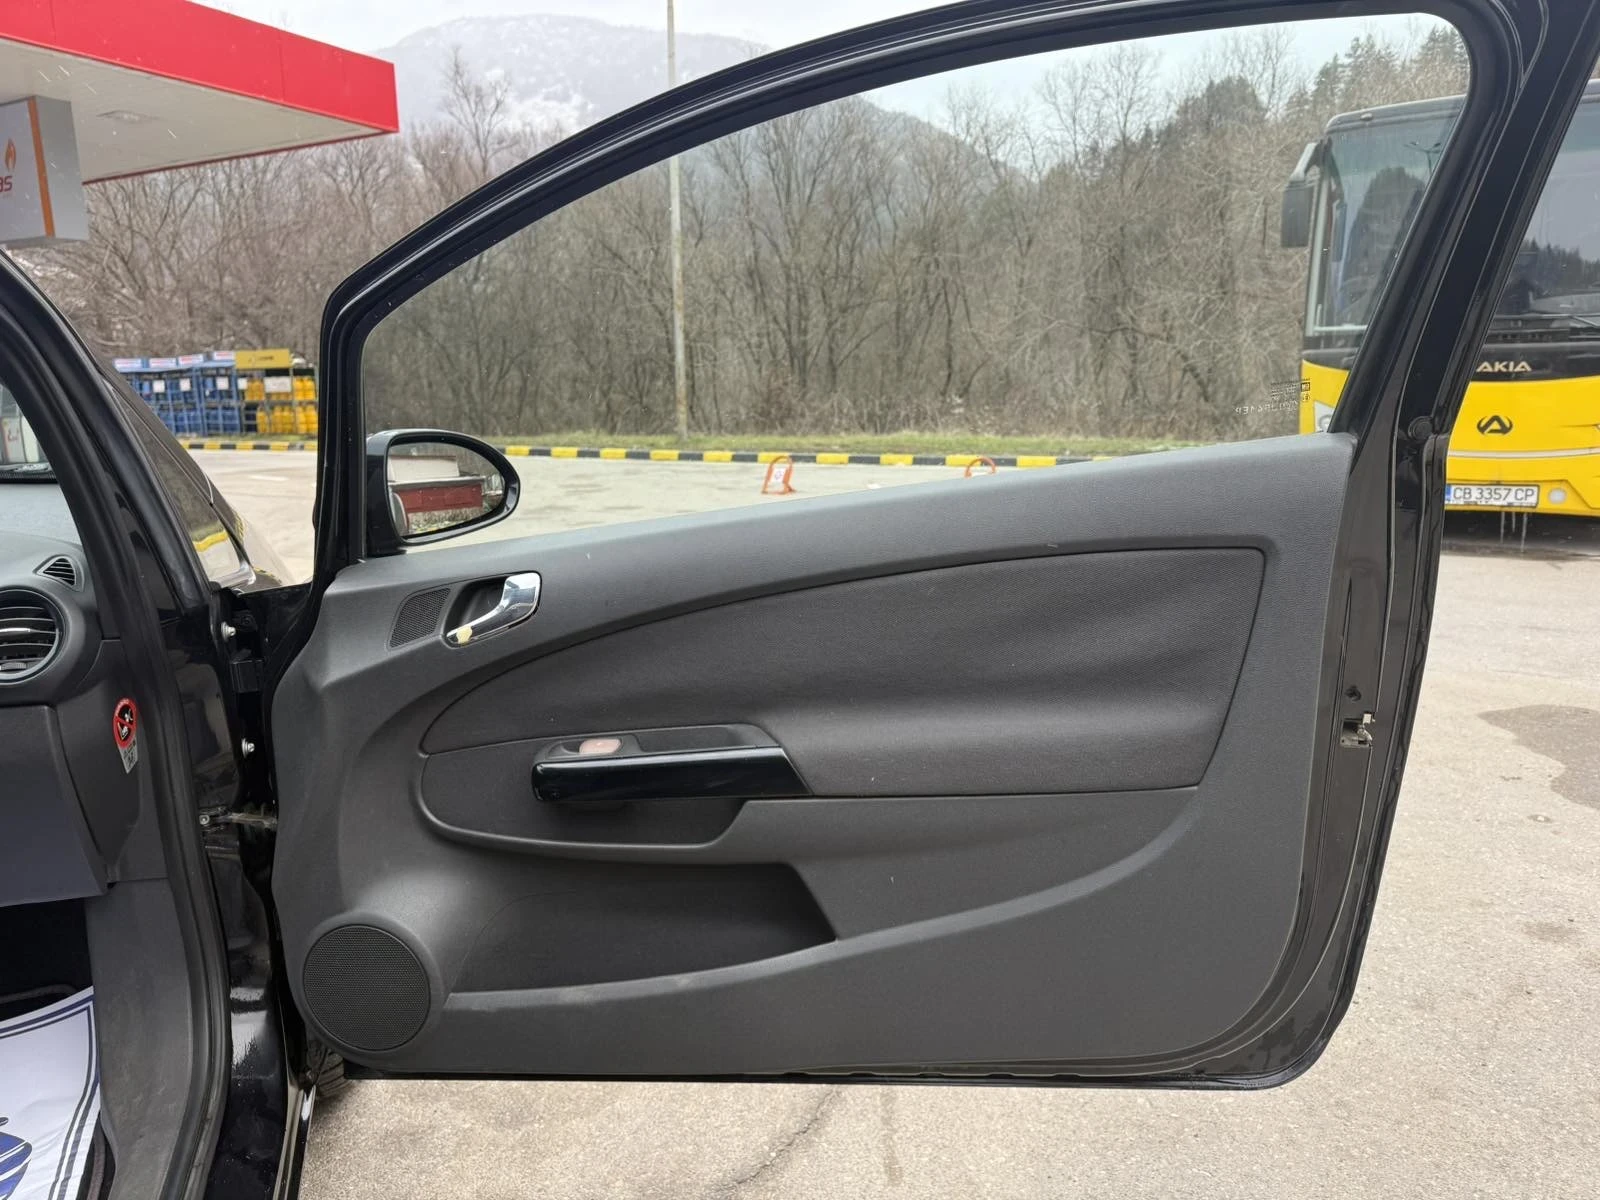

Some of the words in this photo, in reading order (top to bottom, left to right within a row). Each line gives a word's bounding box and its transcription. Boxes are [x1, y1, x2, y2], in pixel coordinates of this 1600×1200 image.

[1476, 361, 1532, 372] AKIA
[1453, 487, 1473, 500] CB
[1475, 487, 1512, 501] 3357
[1514, 488, 1535, 501] CP
